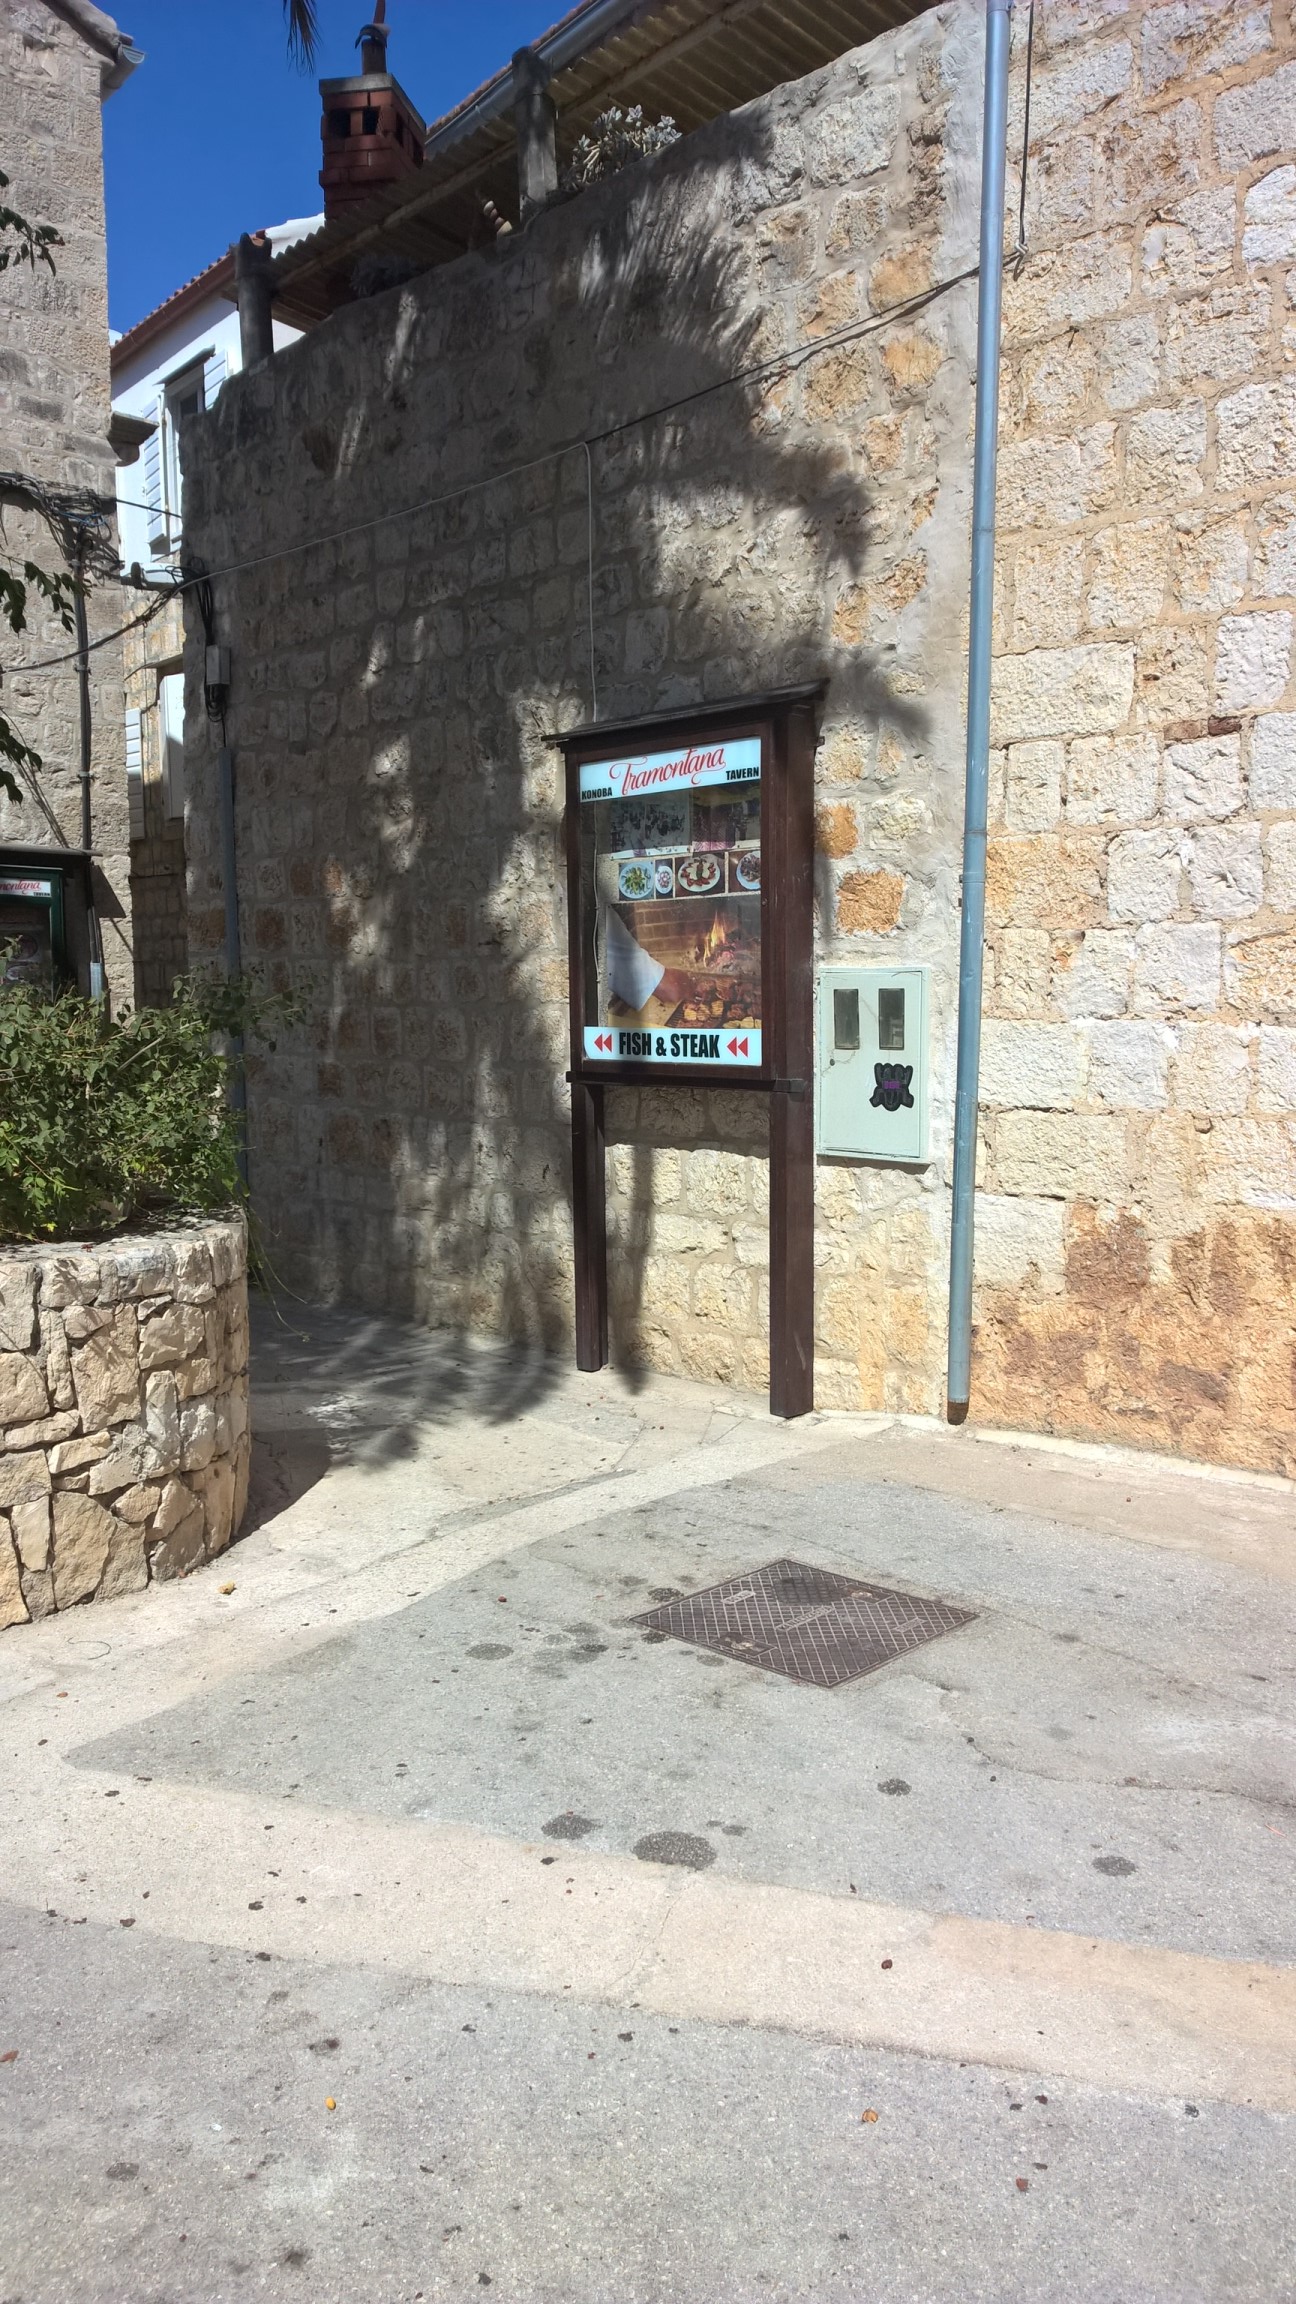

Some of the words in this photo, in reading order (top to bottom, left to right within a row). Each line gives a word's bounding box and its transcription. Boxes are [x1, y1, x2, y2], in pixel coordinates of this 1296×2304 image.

[608, 747, 727, 795] Tramontana
[726, 767, 759, 781] TAVERN
[581, 787, 613, 800] KONOBA
[619, 1032, 652, 1055] FISH
[656, 1036, 667, 1057] &
[670, 1034, 720, 1058] STEAK
